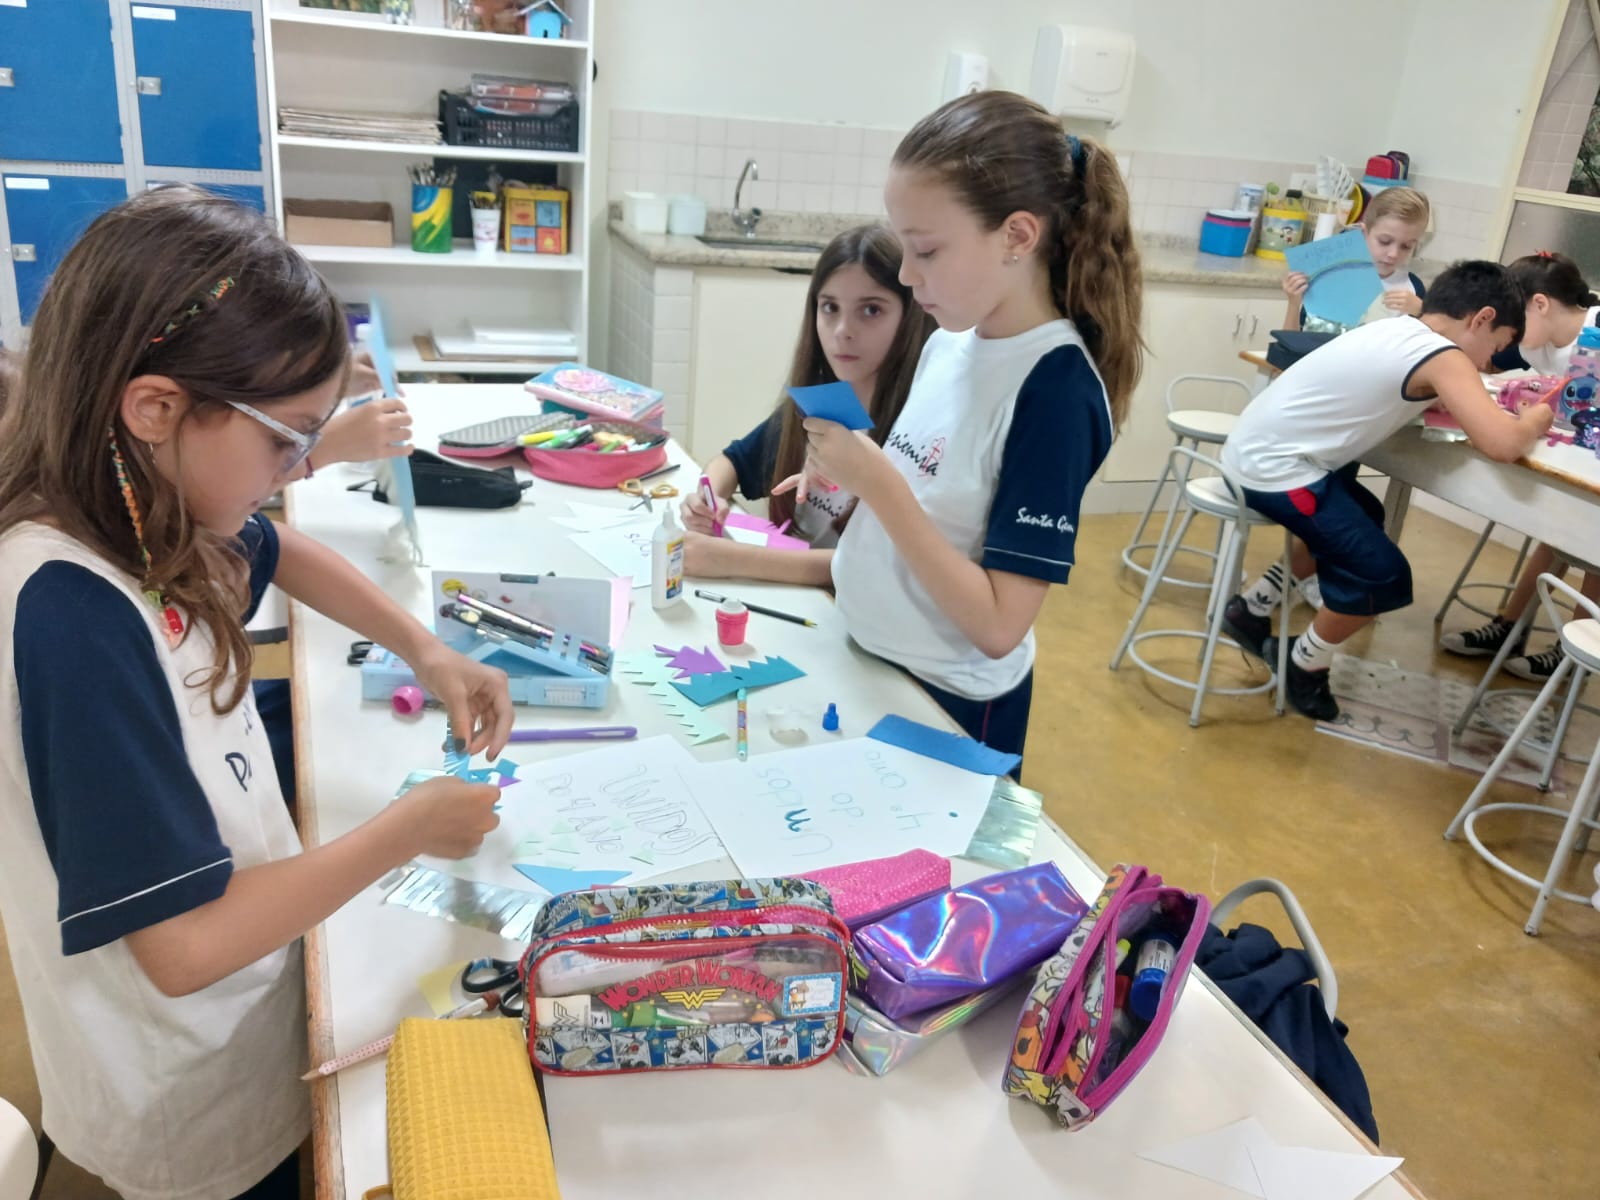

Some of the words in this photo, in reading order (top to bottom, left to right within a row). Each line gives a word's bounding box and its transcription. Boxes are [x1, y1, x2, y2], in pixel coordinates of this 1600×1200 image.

[1016, 506, 1053, 528] Santa
[598, 965, 695, 1011] WONDER
[694, 958, 783, 1003] WOMAN
